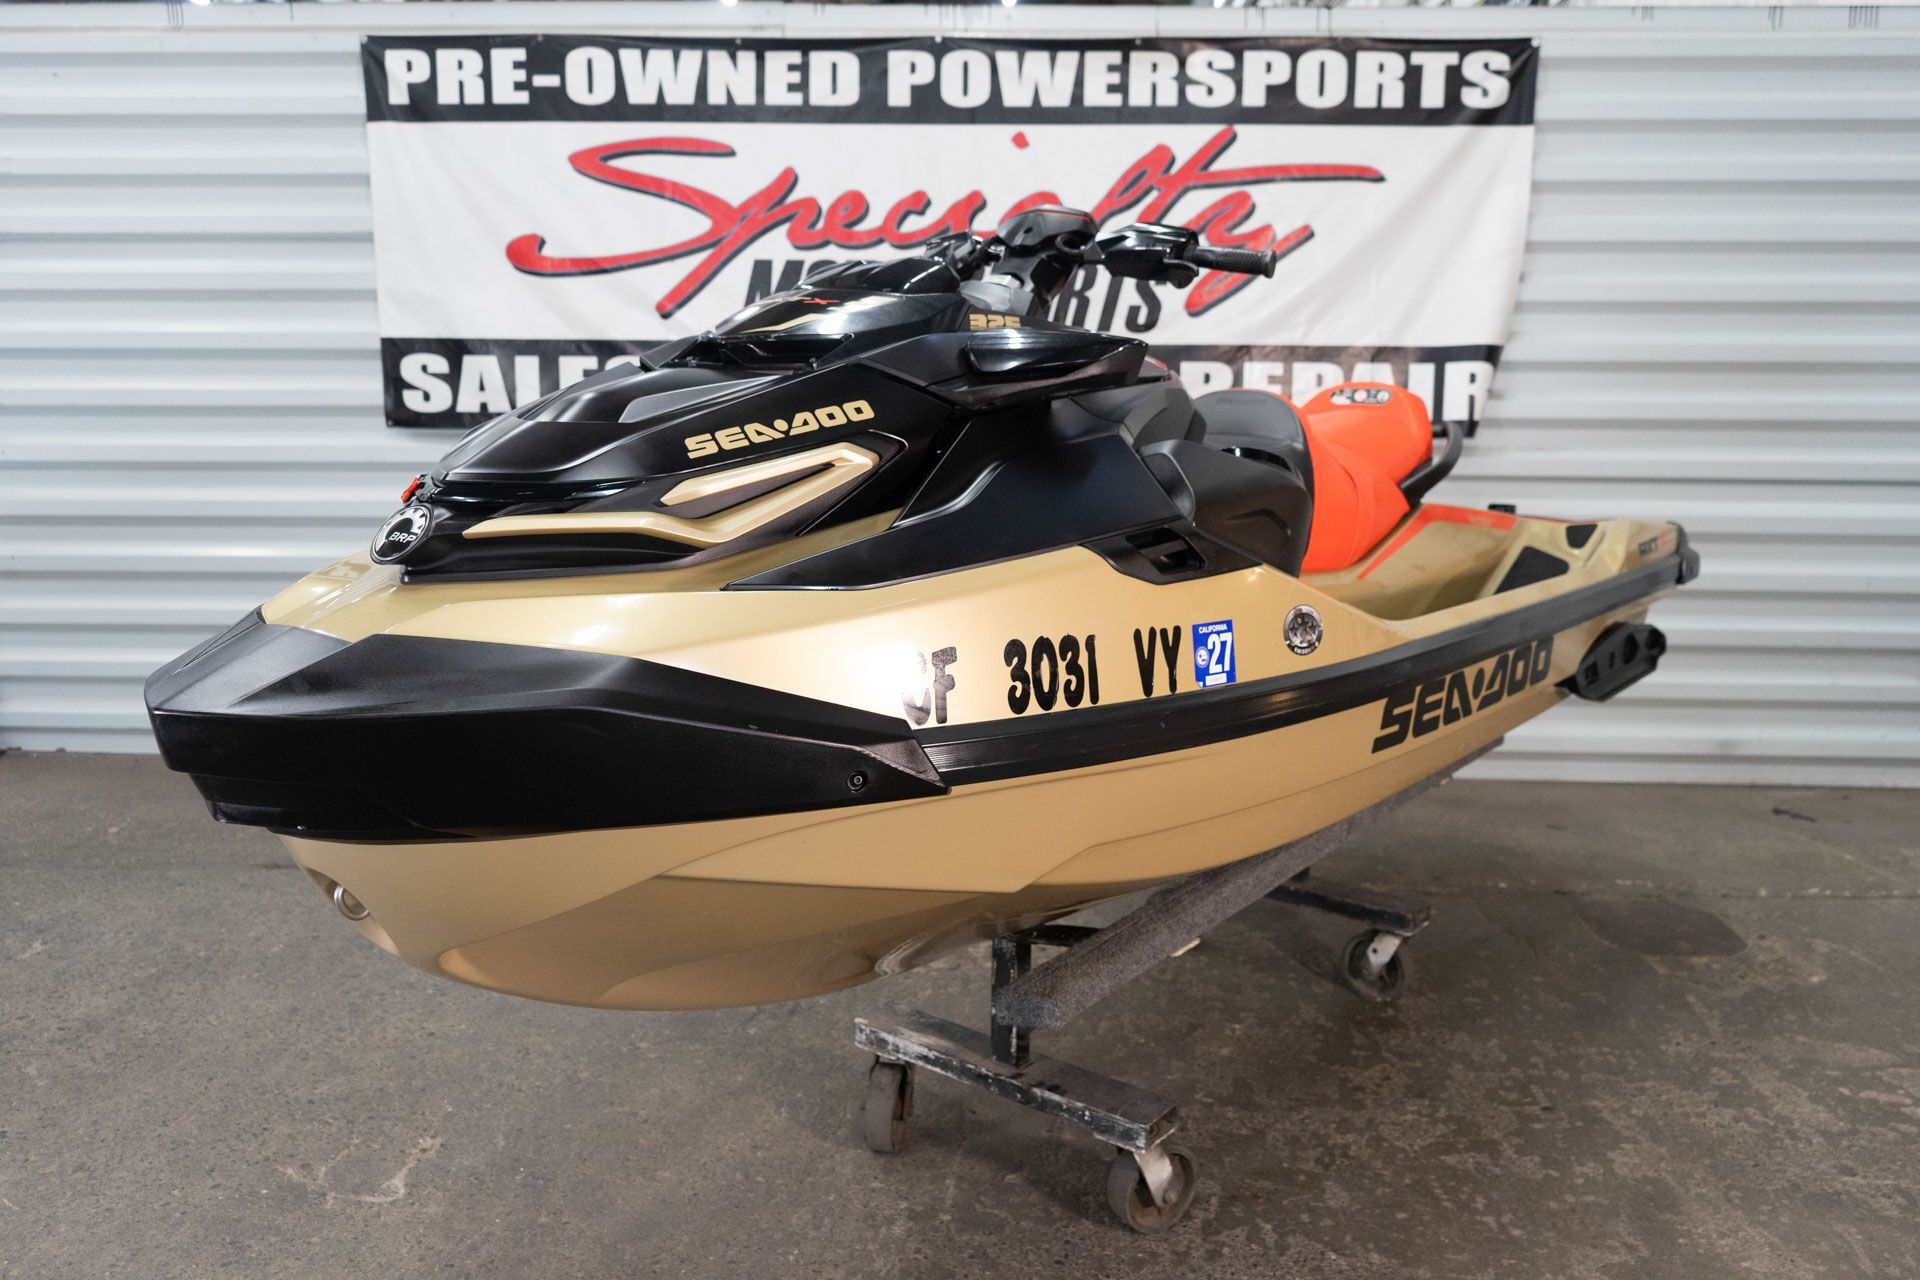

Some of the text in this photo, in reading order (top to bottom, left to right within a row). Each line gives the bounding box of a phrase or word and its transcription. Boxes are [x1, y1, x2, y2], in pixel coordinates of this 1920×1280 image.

[384, 46, 1511, 110] PRE-OWNED POWERSPORTS
[388, 531, 417, 543] BRP
[1198, 623, 1228, 634] CALIFORNIA
[1003, 633, 1099, 715] 3031
[1133, 624, 1181, 698] VY
[1207, 631, 1233, 674] 27
